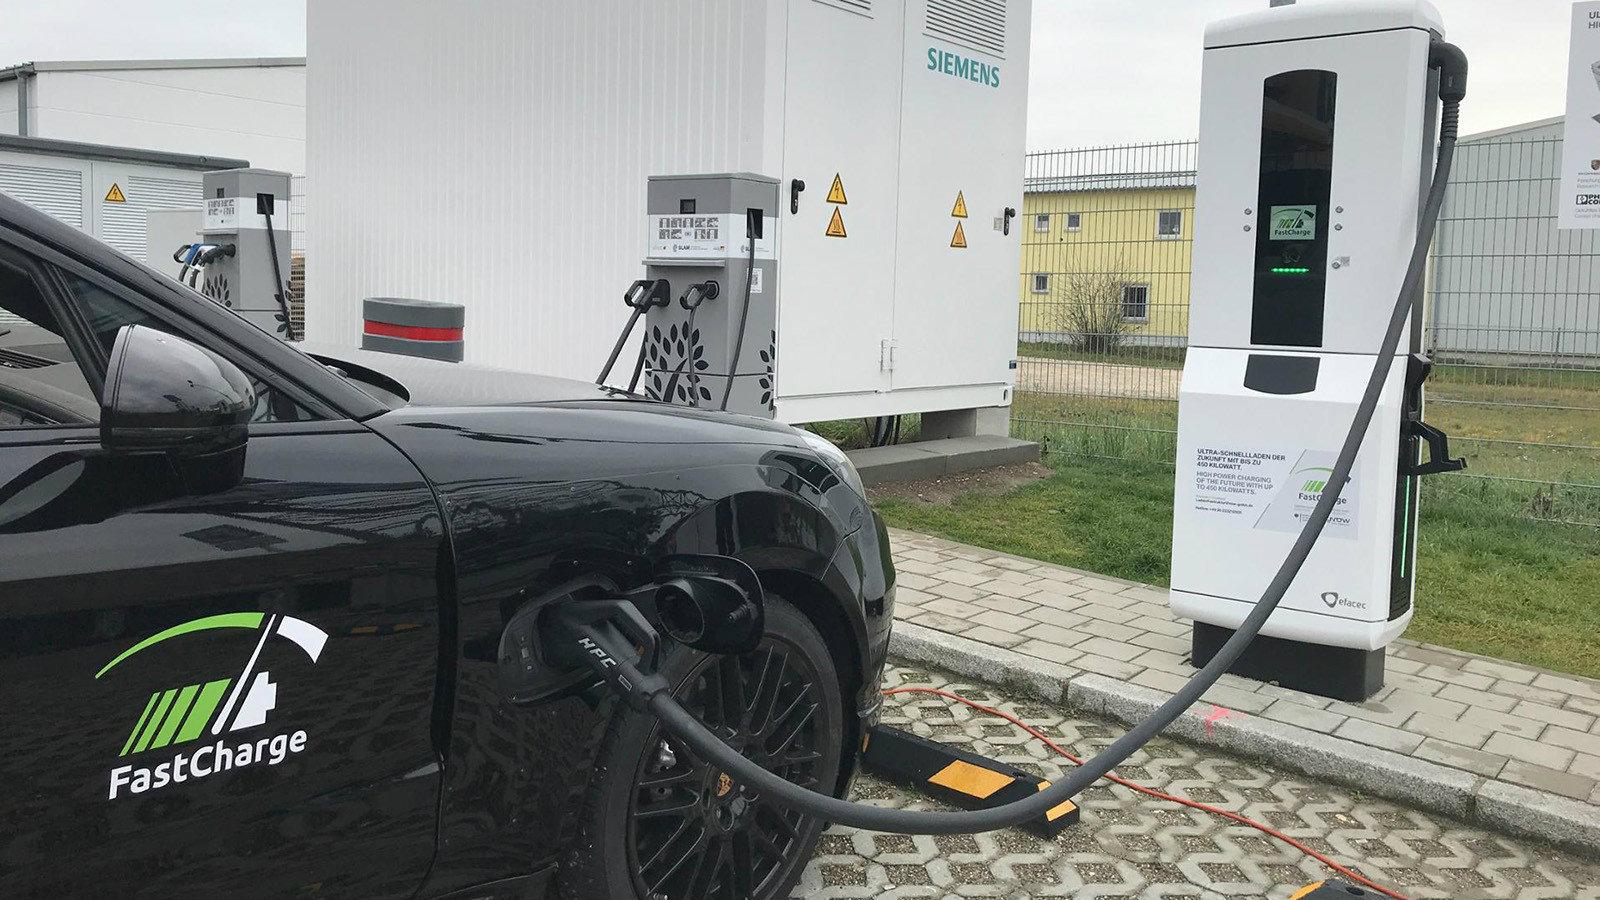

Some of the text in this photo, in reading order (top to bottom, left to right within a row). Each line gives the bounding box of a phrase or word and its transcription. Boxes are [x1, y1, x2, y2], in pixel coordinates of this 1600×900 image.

[927, 47, 999, 88] SIEMENS
[1197, 448, 1271, 460] ULTRA-SCHNELLLADEN
[1209, 462, 1242, 470] KILOWATT.
[1213, 472, 1236, 480] POWER
[1237, 474, 1271, 483] CHARGING
[1218, 486, 1256, 495] KILOWATTS.
[1298, 492, 1347, 505] FastCge
[1339, 598, 1366, 609] efacec
[578, 637, 617, 668] HPC
[108, 730, 307, 800] FastCharge
